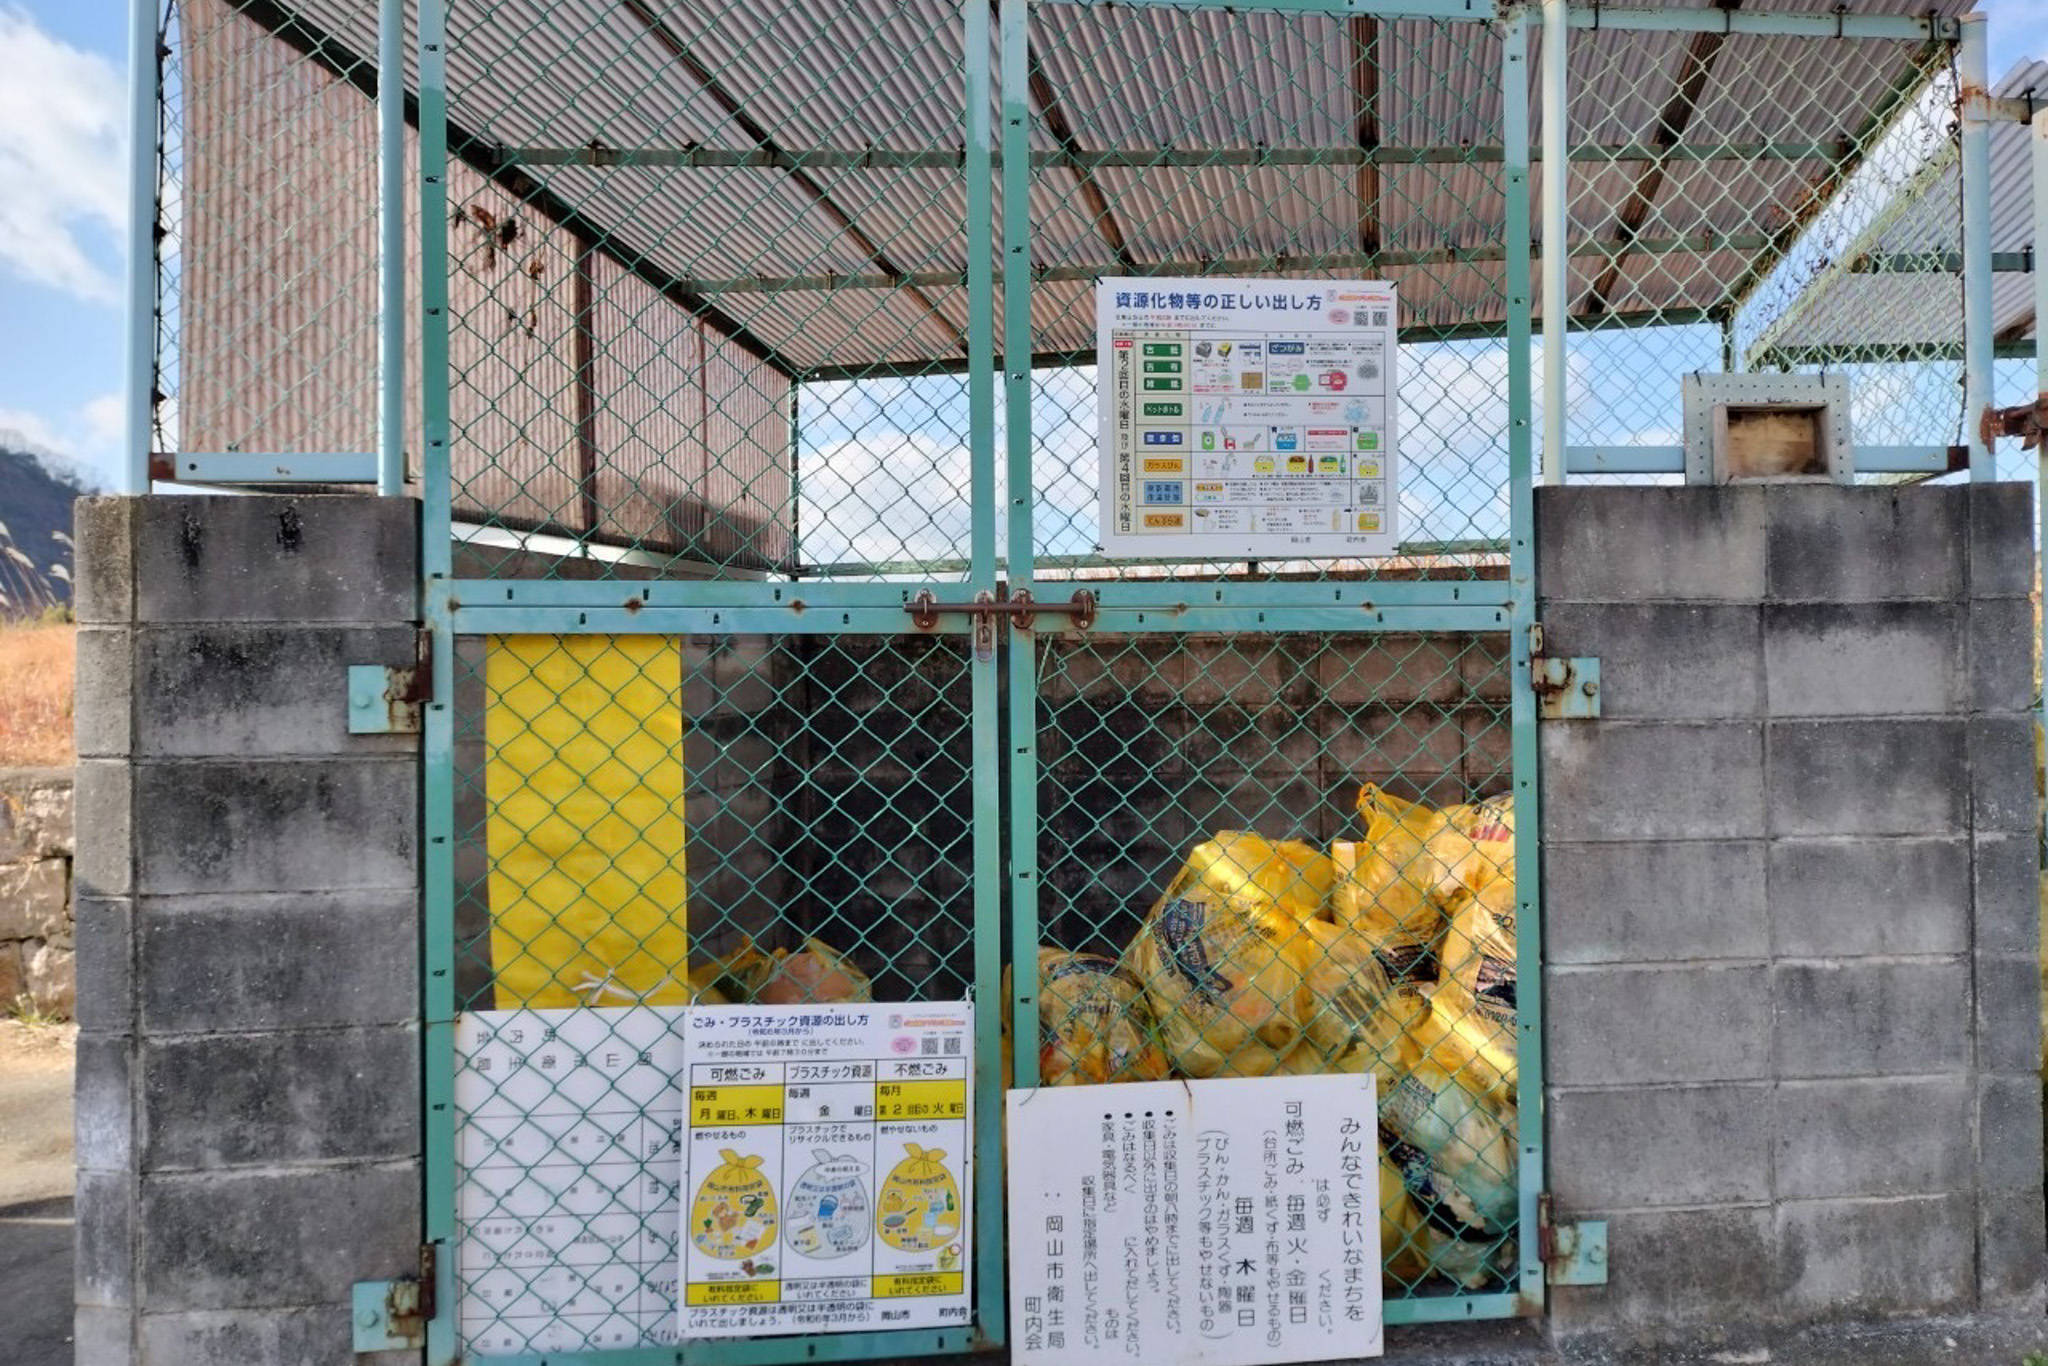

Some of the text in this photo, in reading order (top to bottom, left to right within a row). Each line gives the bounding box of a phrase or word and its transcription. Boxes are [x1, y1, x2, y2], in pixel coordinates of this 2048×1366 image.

[1115, 291, 1322, 311] 資源化物等の正しい出し方
[692, 1014, 869, 1029] ごみ・プラスチック資源の出し方
[710, 1067, 765, 1082] 可燃ごみ
[790, 1064, 872, 1079] プラスチック資源
[894, 1062, 947, 1077] 不燃ごみ
[695, 1090, 717, 1101] 毎週
[788, 1087, 810, 1099] 毎週
[880, 1085, 901, 1097] 毎月
[700, 1107, 711, 1120] 月
[745, 1107, 757, 1119] 木
[761, 1107, 781, 1119] 曜日
[819, 1104, 873, 1117] 金 曜日
[932, 1102, 944, 1114] 火
[949, 1102, 964, 1114] 曜日
[695, 1130, 746, 1141] 燃やせるもの
[788, 1124, 847, 1134] プラスチックで
[880, 1124, 938, 1135] 燃やせないもの
[788, 1133, 872, 1144] リサイクルできるもの
[1284, 1100, 1305, 1174] 可燃ごみ
[1235, 1197, 1254, 1234] 毎週
[1340, 1117, 1365, 1322] みんなできれいなまちを
[785, 1278, 868, 1291] 透明又は半透明の袋に
[1046, 1215, 1065, 1350] 岡山市衛生局
[796, 1289, 857, 1300] いれてください
[888, 1285, 947, 1295] いれてください
[703, 1293, 764, 1303] いれてください
[881, 1309, 911, 1321] 岡山市
[1024, 1296, 1042, 1351] 町内会
